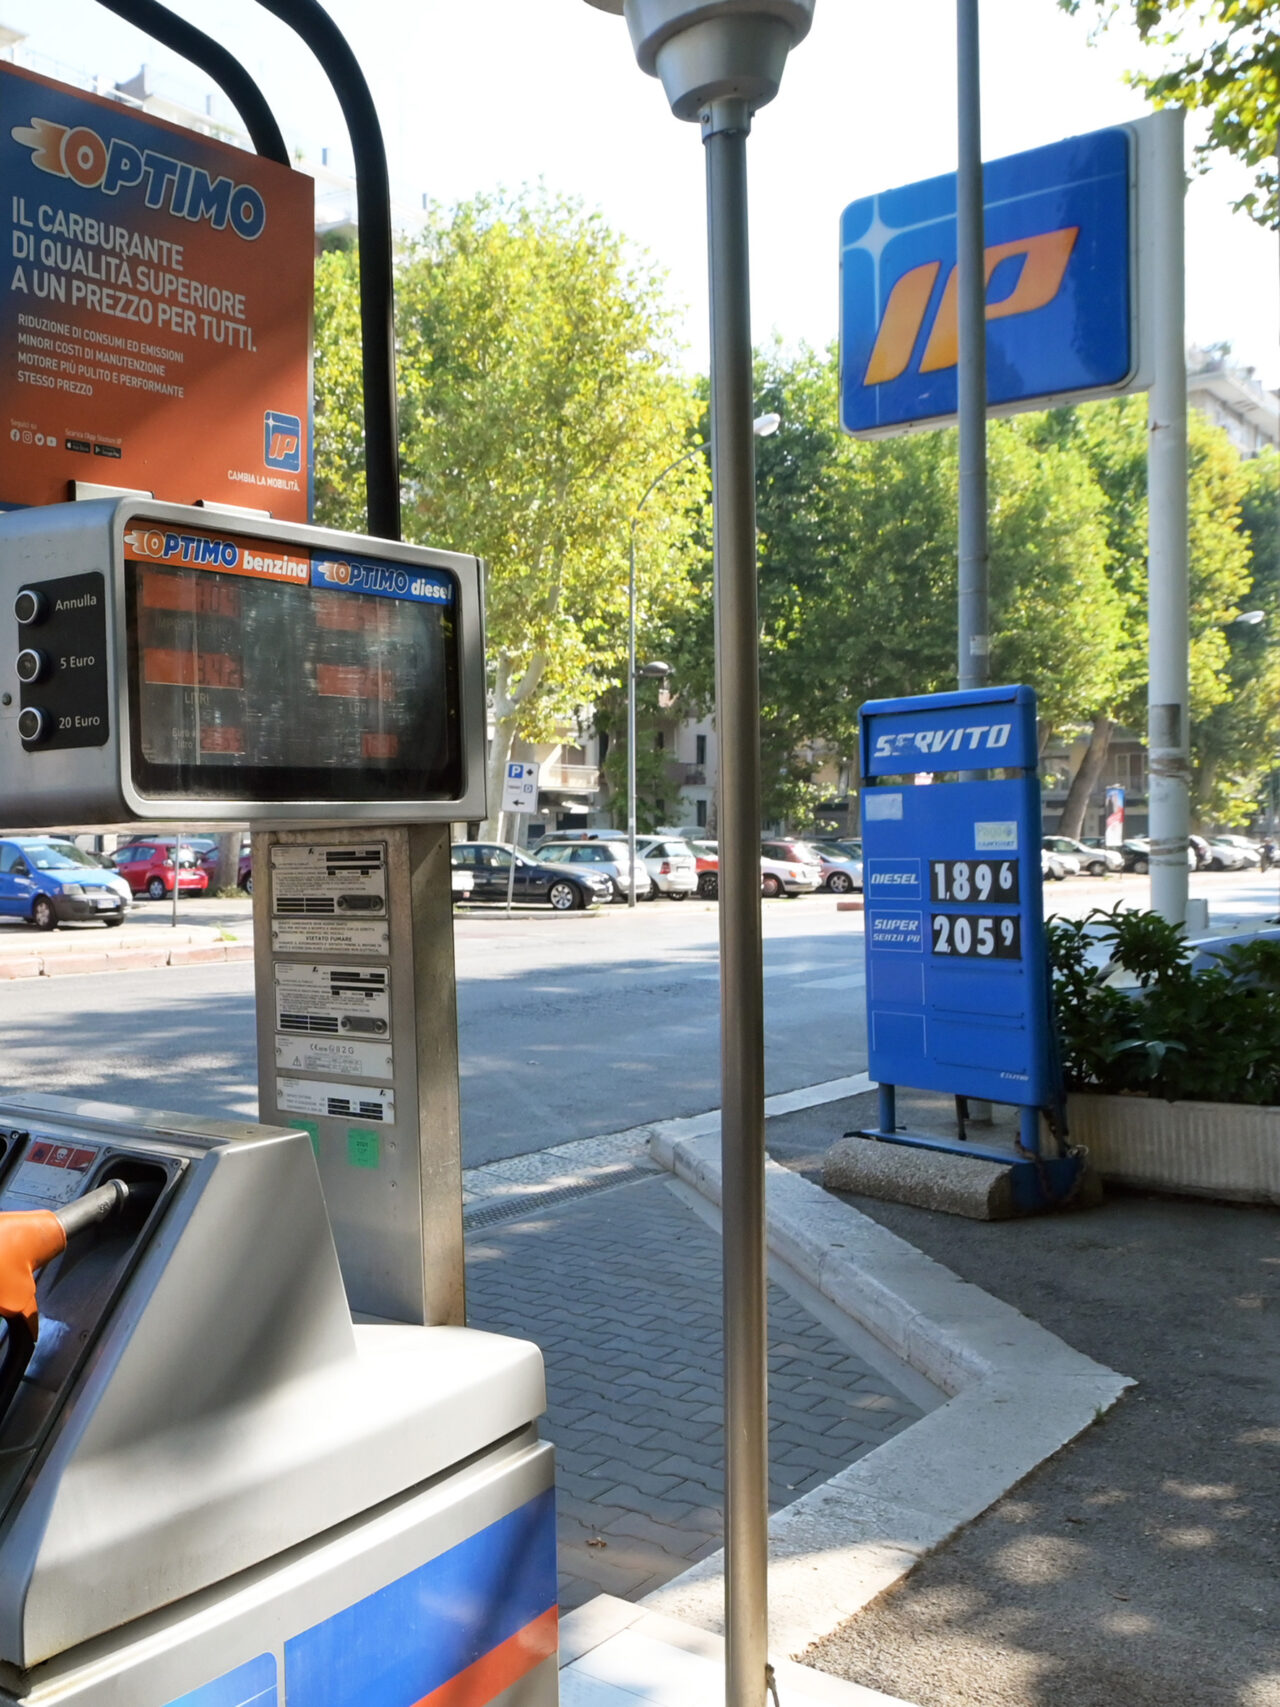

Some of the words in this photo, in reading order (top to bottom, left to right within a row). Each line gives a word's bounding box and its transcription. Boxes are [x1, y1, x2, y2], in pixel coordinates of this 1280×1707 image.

[62, 126, 267, 241] OPTIMO
[12, 196, 34, 228] IL
[38, 204, 184, 271] CARBURANTE
[12, 230, 34, 261] DI
[40, 239, 133, 288] QUALITÀ
[136, 265, 246, 319] SUPERIORE
[11, 265, 28, 294] A
[33, 270, 66, 303] UN
[71, 279, 153, 324] PREZZO
[158, 304, 197, 337] PER
[200, 314, 257, 352] TUTTI.
[18, 313, 70, 336] RIDUZIONE
[73, 326, 82, 339] DI
[83, 329, 125, 349] CONSUMI
[127, 340, 139, 351] ED
[140, 343, 184, 363] EMISSIONI
[18, 333, 54, 350] MINORI
[56, 342, 83, 357] COSTI
[85, 347, 94, 360] DI
[95, 351, 165, 377] MANUTENZIONE
[17, 370, 54, 388] STESSO
[57, 378, 93, 396] PREZZO
[18, 352, 58, 371] MOTORE
[60, 359, 76, 375] PIÙ
[78, 364, 111, 382] PULITO
[112, 372, 118, 384] E
[120, 374, 184, 398] PERFORMANTE
[269, 433, 297, 460] IP
[228, 470, 256, 484] CAMBIA
[257, 476, 266, 486] LA
[144, 530, 238, 567] OPTIMO
[242, 551, 308, 579] benzina
[334, 560, 408, 594] OPTIMO
[411, 578, 452, 600] diesel
[55, 594, 97, 611] Annulla
[60, 657, 67, 669] 5
[70, 655, 95, 668] Euro
[58, 716, 72, 730] 20
[75, 714, 100, 728] Euro
[874, 723, 1012, 757] SERVITO
[511, 765, 521, 777] P
[871, 873, 919, 885] DIESEL
[873, 933, 904, 943] SENZA
[874, 918, 918, 931] SUPER
